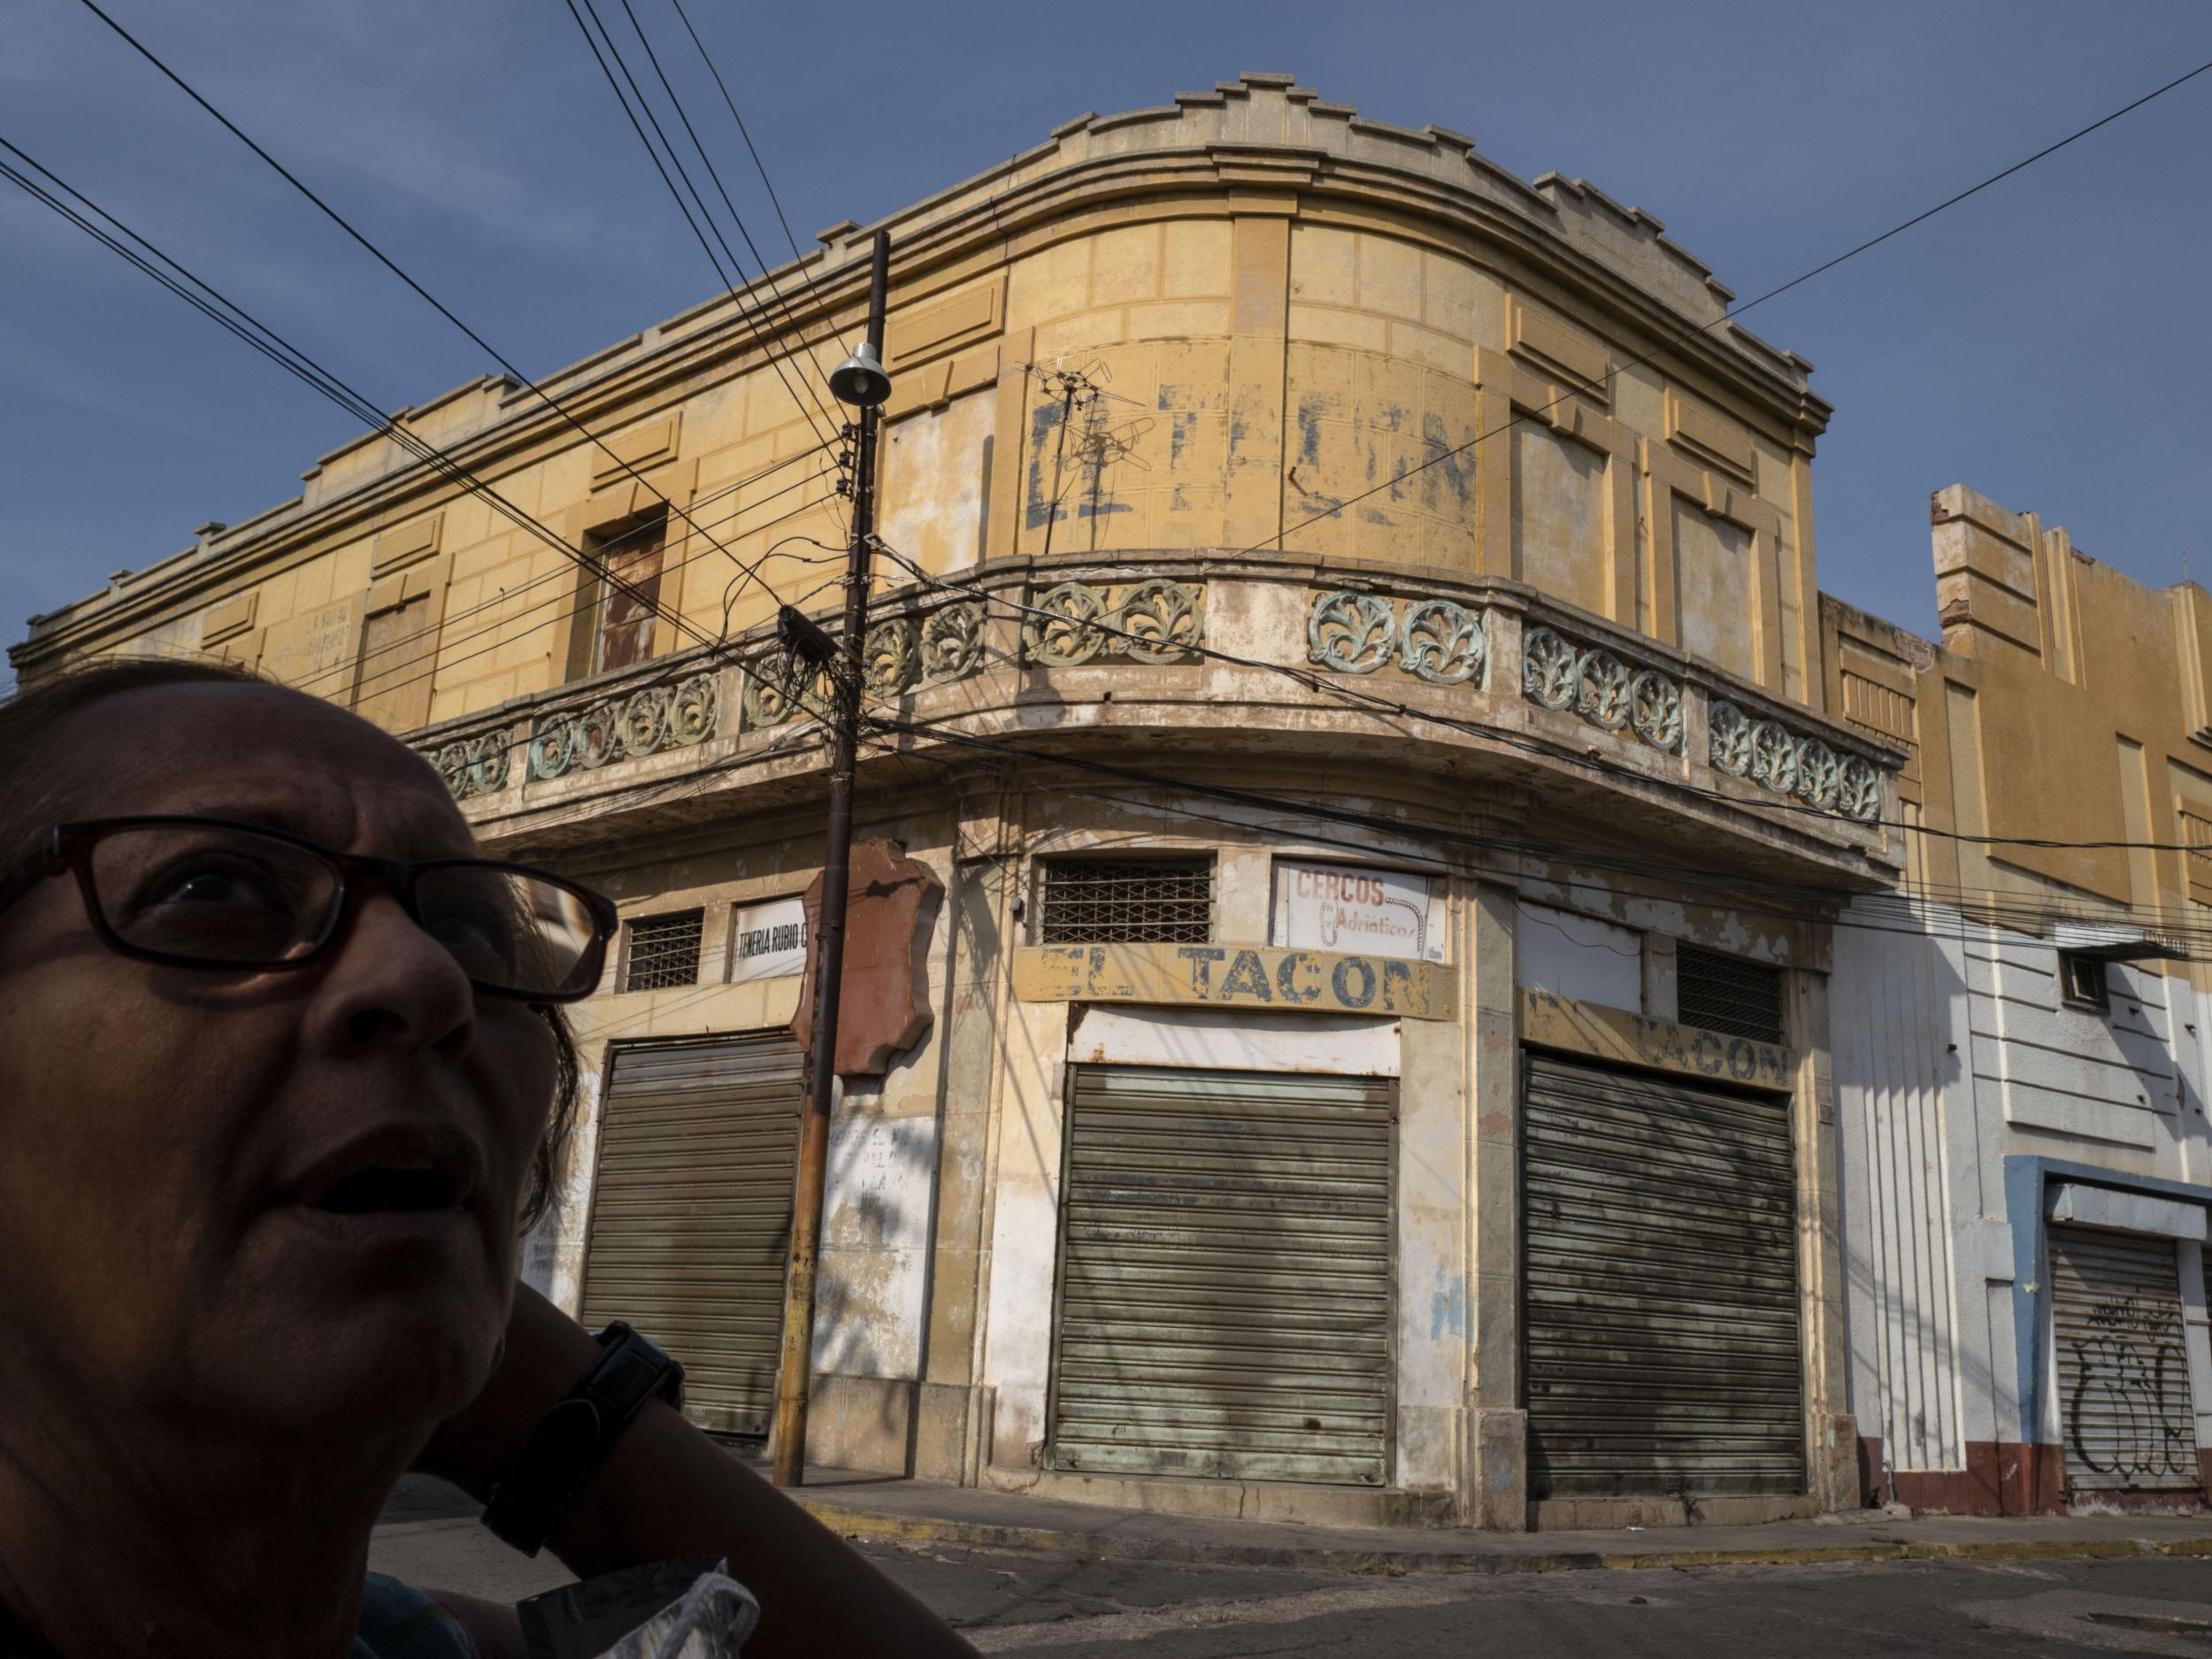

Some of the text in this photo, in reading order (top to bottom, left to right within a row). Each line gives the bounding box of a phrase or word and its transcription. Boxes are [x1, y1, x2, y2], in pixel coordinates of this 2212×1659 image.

[1296, 869, 1385, 907] CERCOS
[739, 928, 770, 959] TENERIA
[772, 924, 798, 953] RUBIO
[1178, 947, 1429, 1013] TACON
